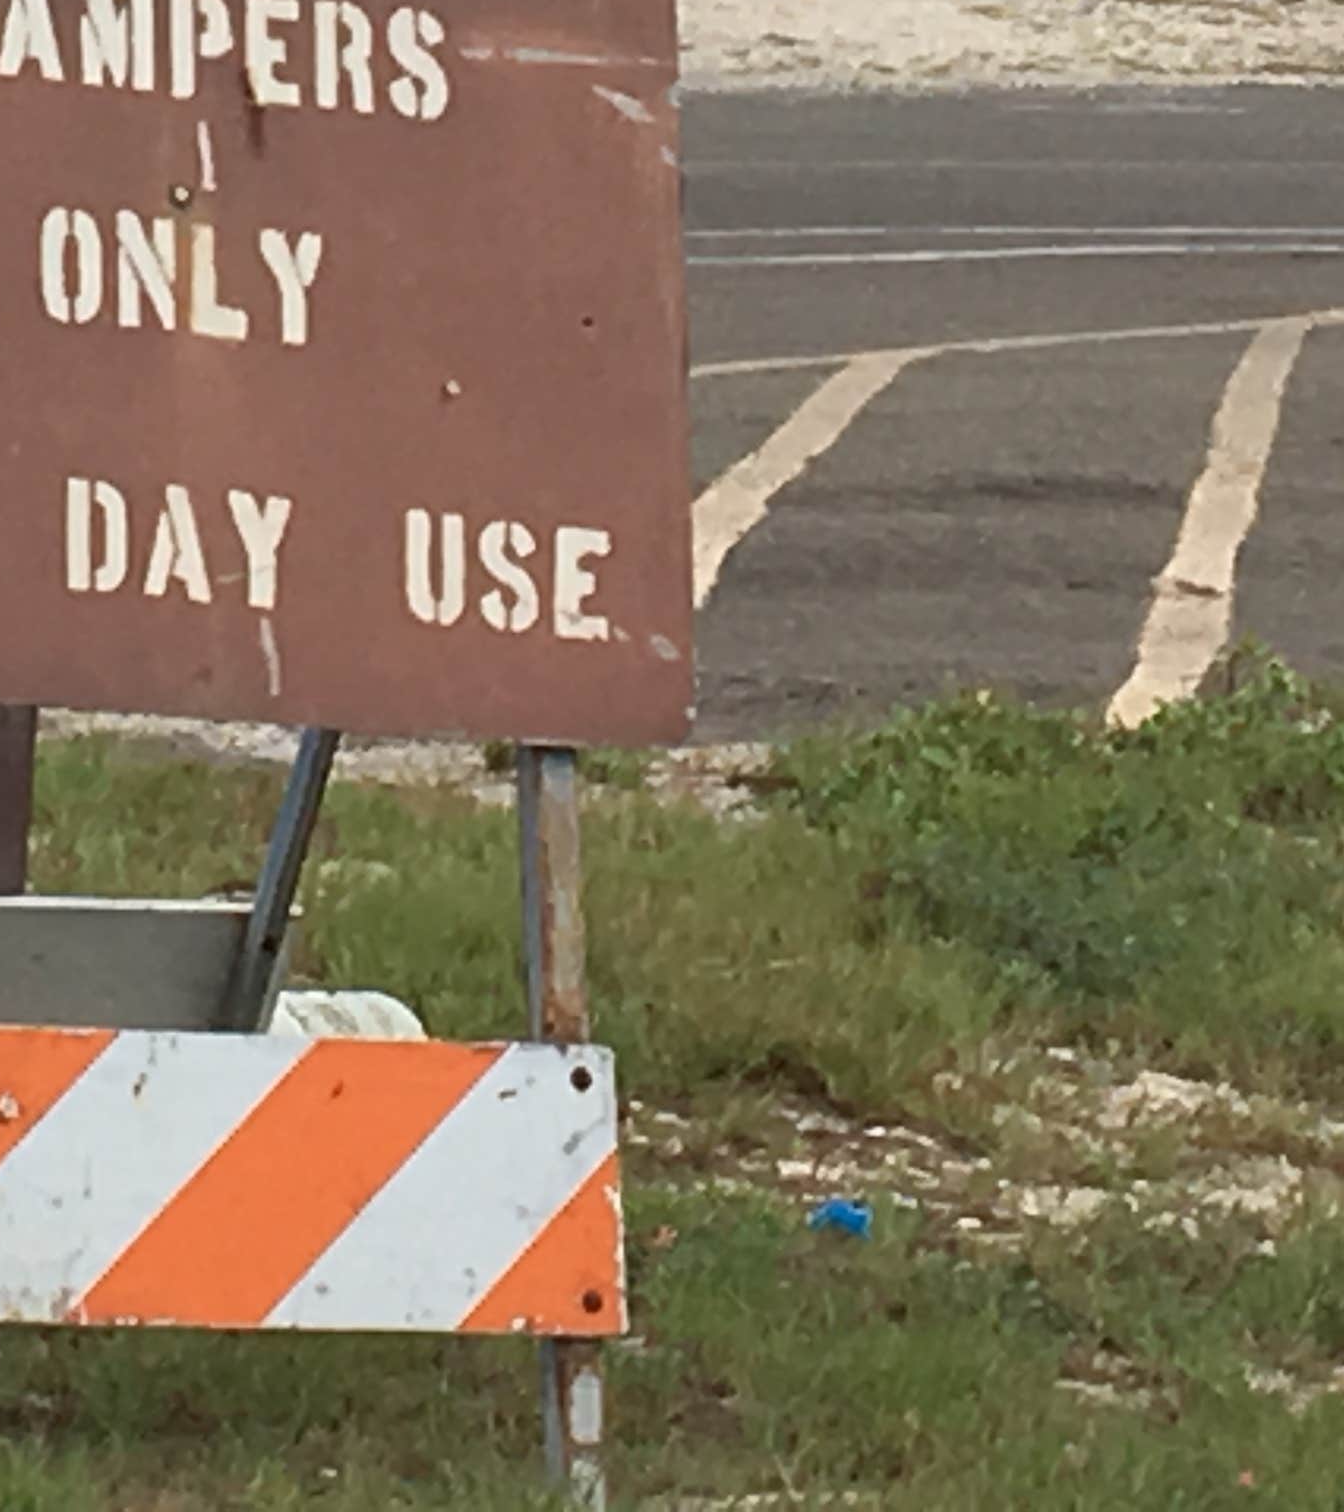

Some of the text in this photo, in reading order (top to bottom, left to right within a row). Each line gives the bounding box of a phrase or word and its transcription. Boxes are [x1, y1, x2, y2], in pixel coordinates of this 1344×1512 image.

[40, 205, 324, 346] ONLY
[64, 476, 292, 610] DAY
[403, 507, 613, 641] USE
